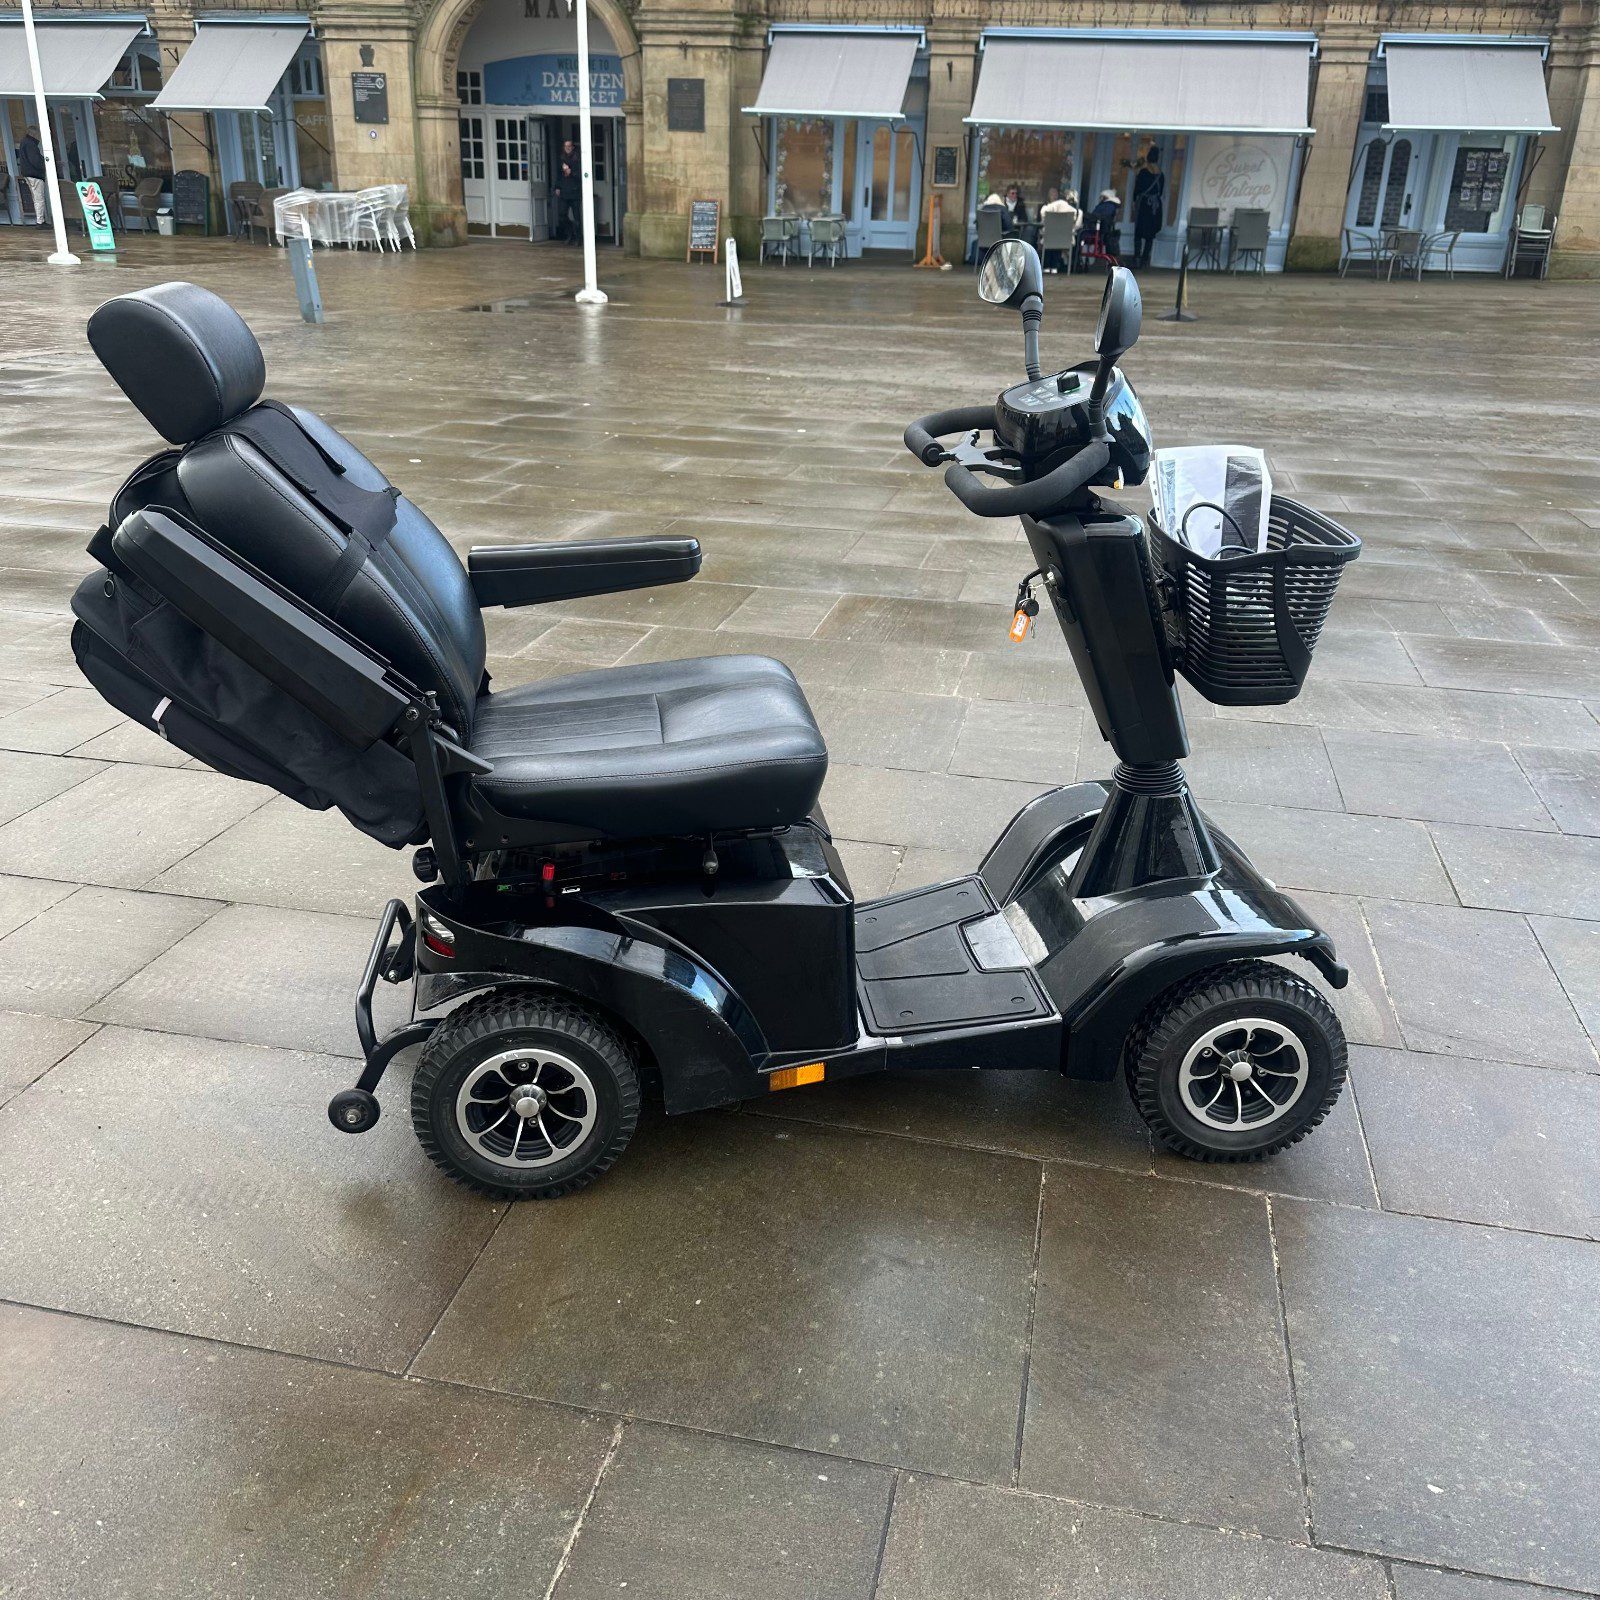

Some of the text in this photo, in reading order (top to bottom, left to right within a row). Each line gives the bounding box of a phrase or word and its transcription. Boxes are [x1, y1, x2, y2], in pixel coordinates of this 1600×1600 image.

[551, 90, 617, 103] MAKET
[1216, 153, 1265, 174] Sweet
[1206, 173, 1272, 205] Vintage
